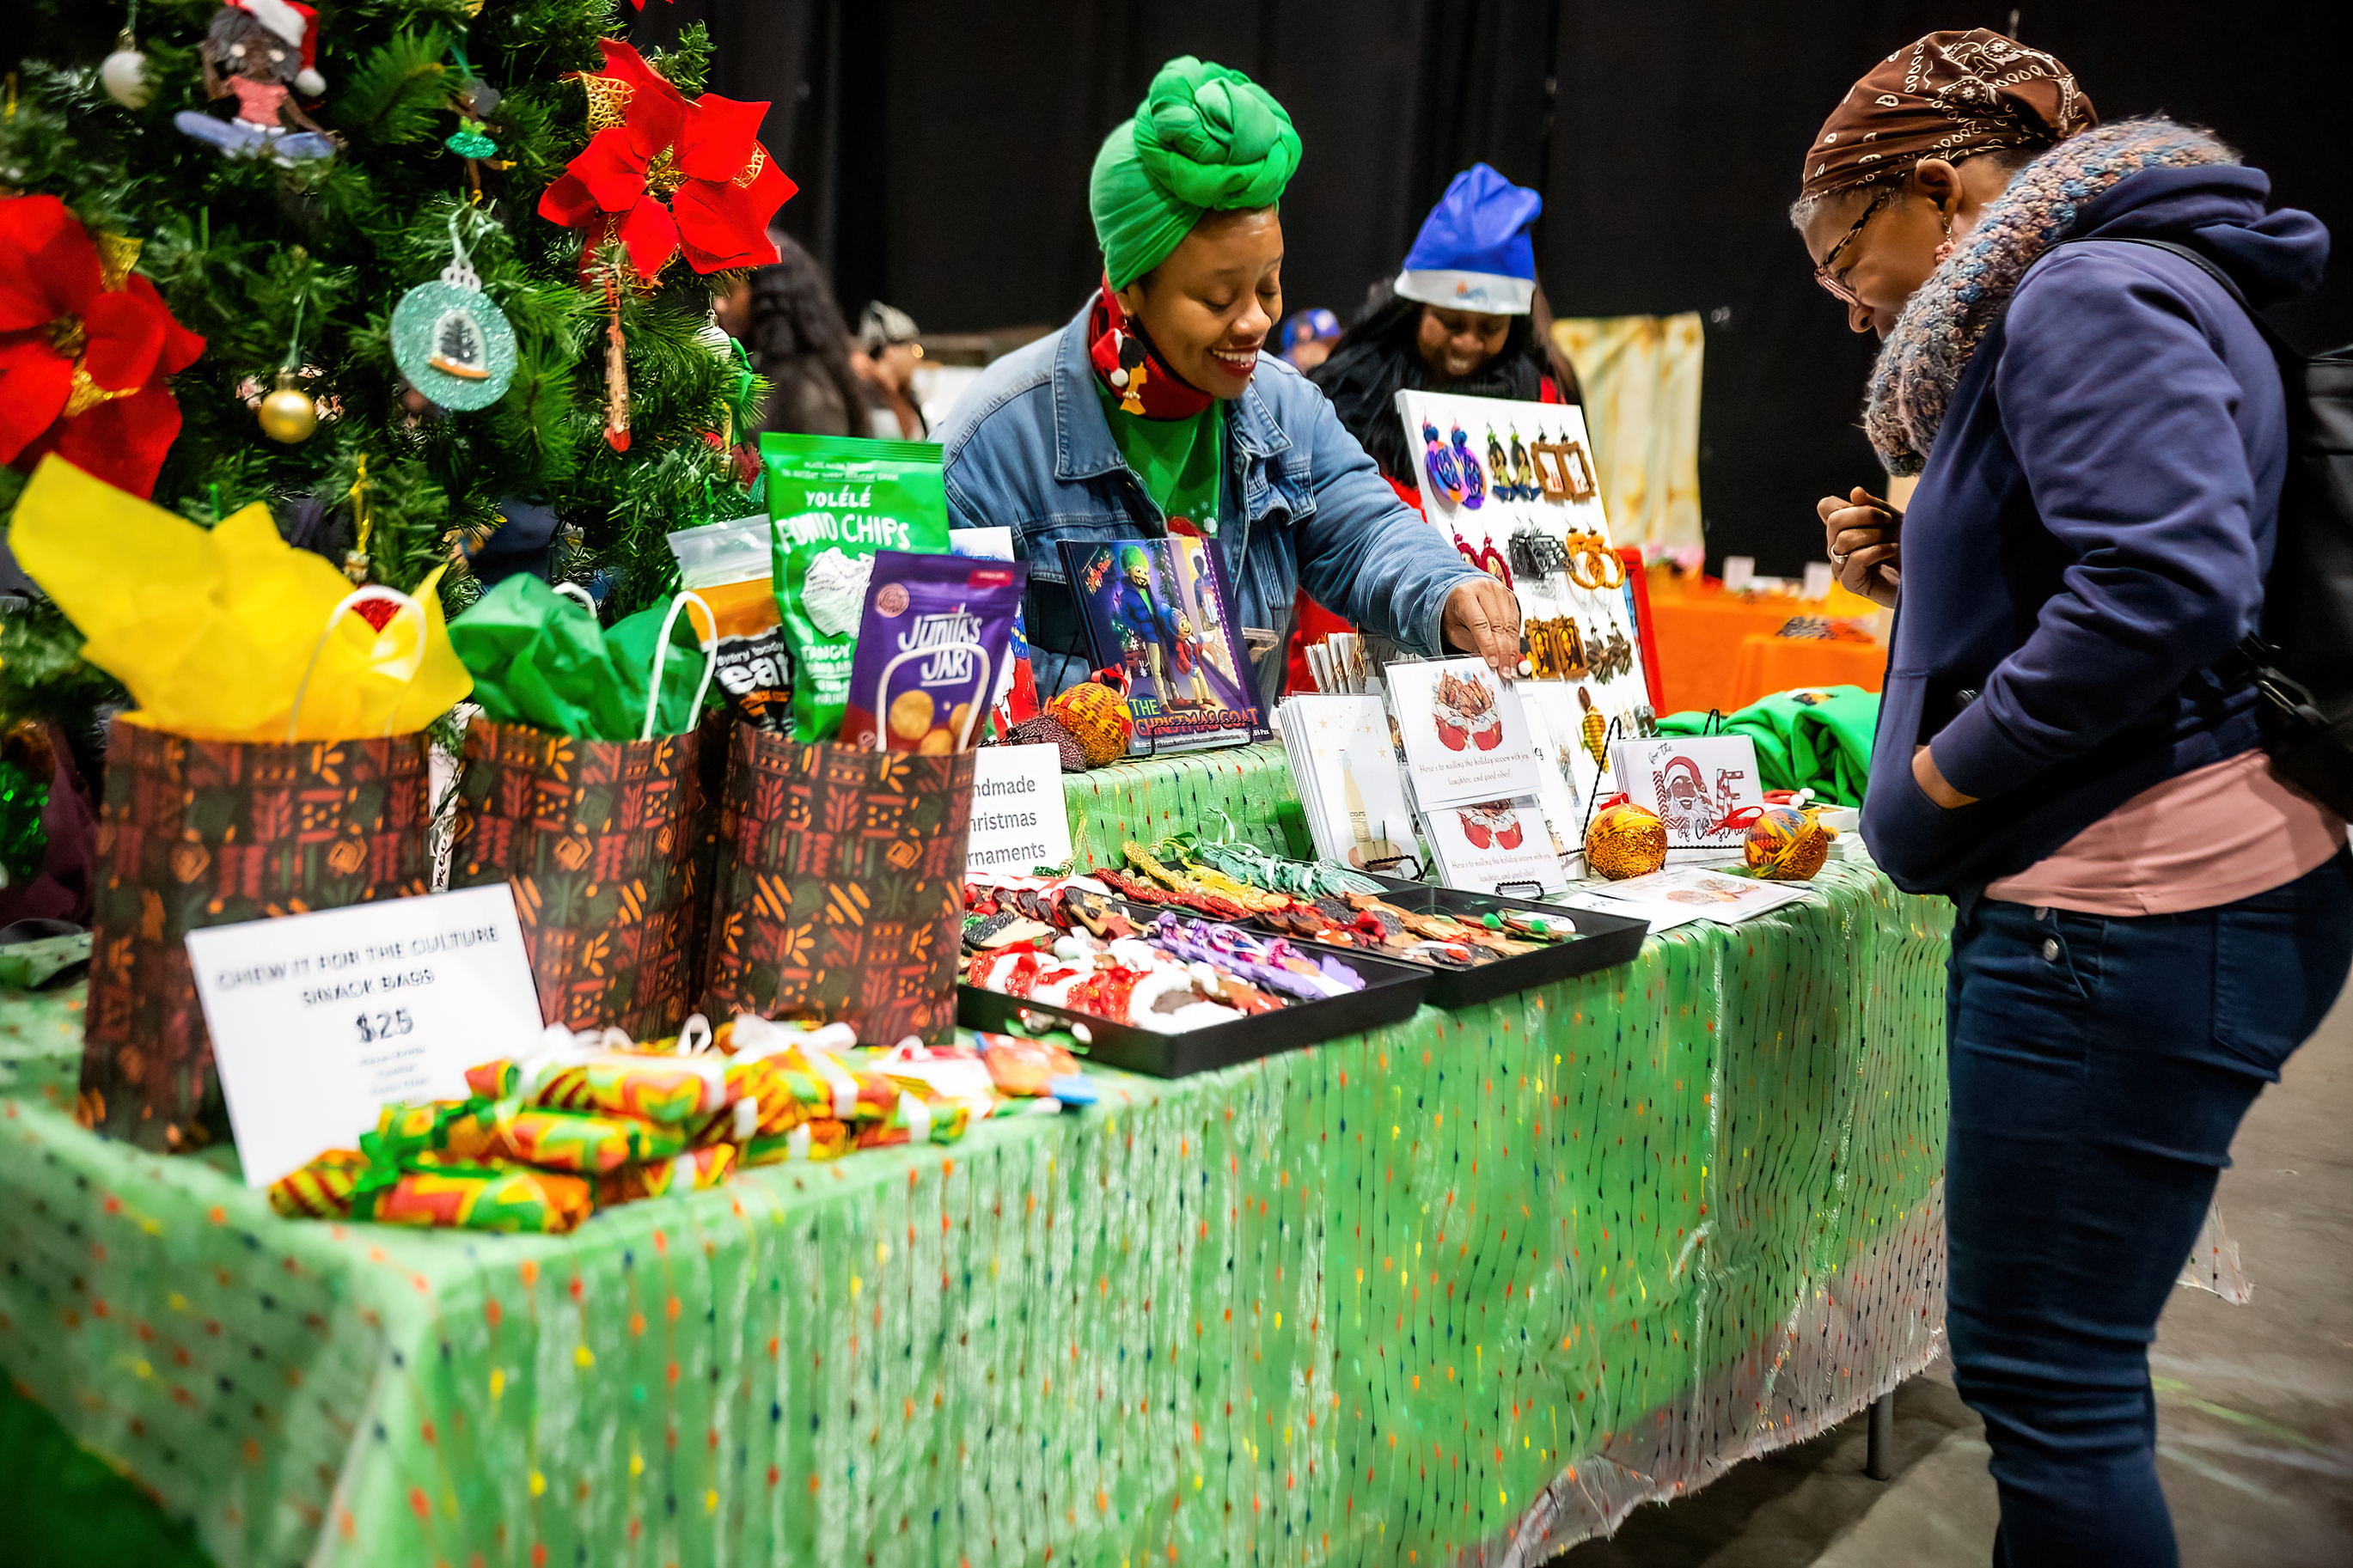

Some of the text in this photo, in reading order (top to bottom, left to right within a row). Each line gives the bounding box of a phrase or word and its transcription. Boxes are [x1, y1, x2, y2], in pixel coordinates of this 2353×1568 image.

[805, 485, 871, 508] YOLÉLÉ
[841, 513, 911, 550] CHIPS
[920, 647, 968, 680] JAR
[1129, 699, 1160, 716] THE
[1135, 708, 1259, 736] CHRISTMAS COAT
[1465, 758, 1474, 766] the
[972, 776, 1036, 798] ndmade
[1473, 772, 1482, 782] and
[1484, 771, 1496, 782] good
[969, 812, 1037, 833] ristmas
[967, 843, 1046, 867] rnaments
[319, 950, 360, 970] FOR
[366, 942, 405, 962] THE
[411, 924, 500, 955] CULTURE
[302, 967, 436, 1007] SNACK BAGS
[355, 1006, 414, 1044] $25
